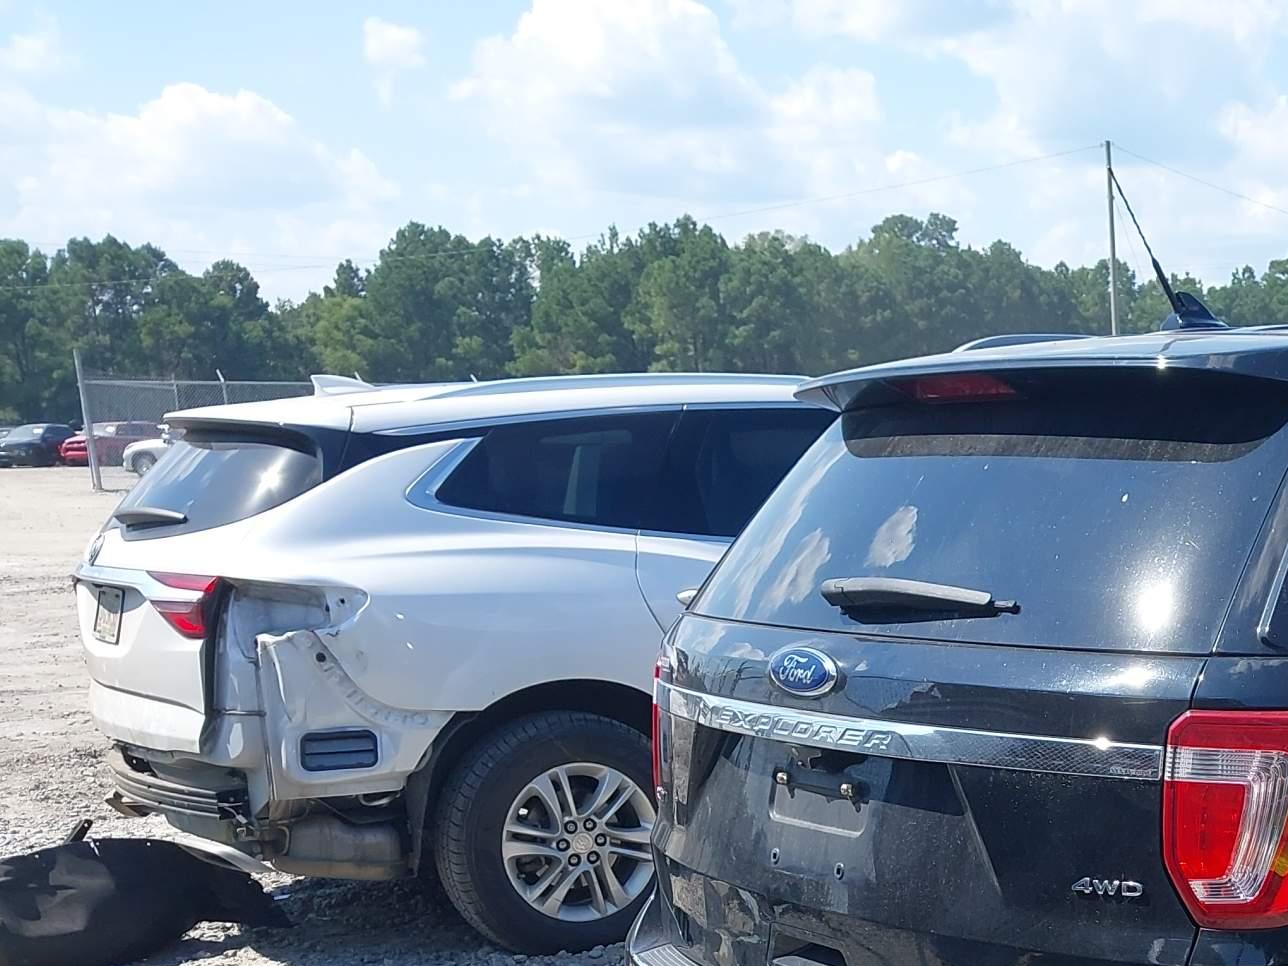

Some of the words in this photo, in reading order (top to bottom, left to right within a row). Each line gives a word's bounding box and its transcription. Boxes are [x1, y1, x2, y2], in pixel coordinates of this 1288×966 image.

[779, 654, 816, 685] Ford
[716, 705, 892, 750] EXPLORER
[1071, 877, 1143, 897] 4WD
